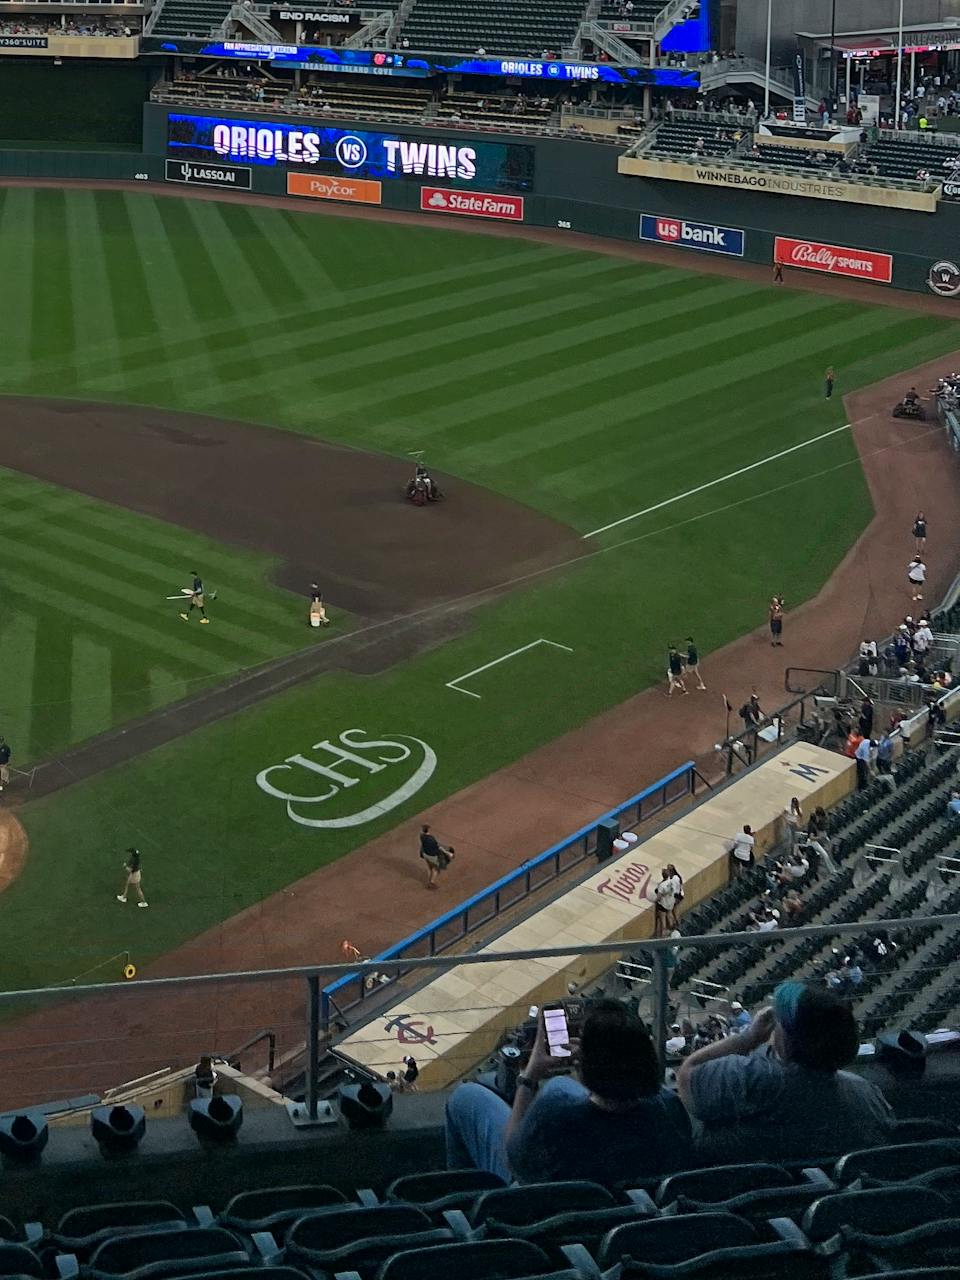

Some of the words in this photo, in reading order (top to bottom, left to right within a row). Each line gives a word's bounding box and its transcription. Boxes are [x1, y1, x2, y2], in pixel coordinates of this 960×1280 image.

[279, 11, 304, 21] END
[304, 13, 350, 23] RACISM
[22, 39, 46, 47] SUITE
[501, 61, 543, 76] ORIOLES
[565, 65, 599, 80] TWINS
[213, 124, 320, 164] ORIOLES
[343, 143, 361, 160] VS
[383, 140, 476, 179] TWINS
[194, 168, 235, 182] LASSO.AI
[696, 169, 766, 187] WINNEBAGO
[767, 178, 843, 197] INDUSTRIES
[310, 180, 356, 197] Paycor
[658, 223, 678, 238] us
[681, 222, 725, 246] bank
[792, 243, 838, 270] Bally
[838, 256, 873, 272] SPORTS
[256, 729, 411, 803] CHS
[597, 862, 649, 904] Twins
